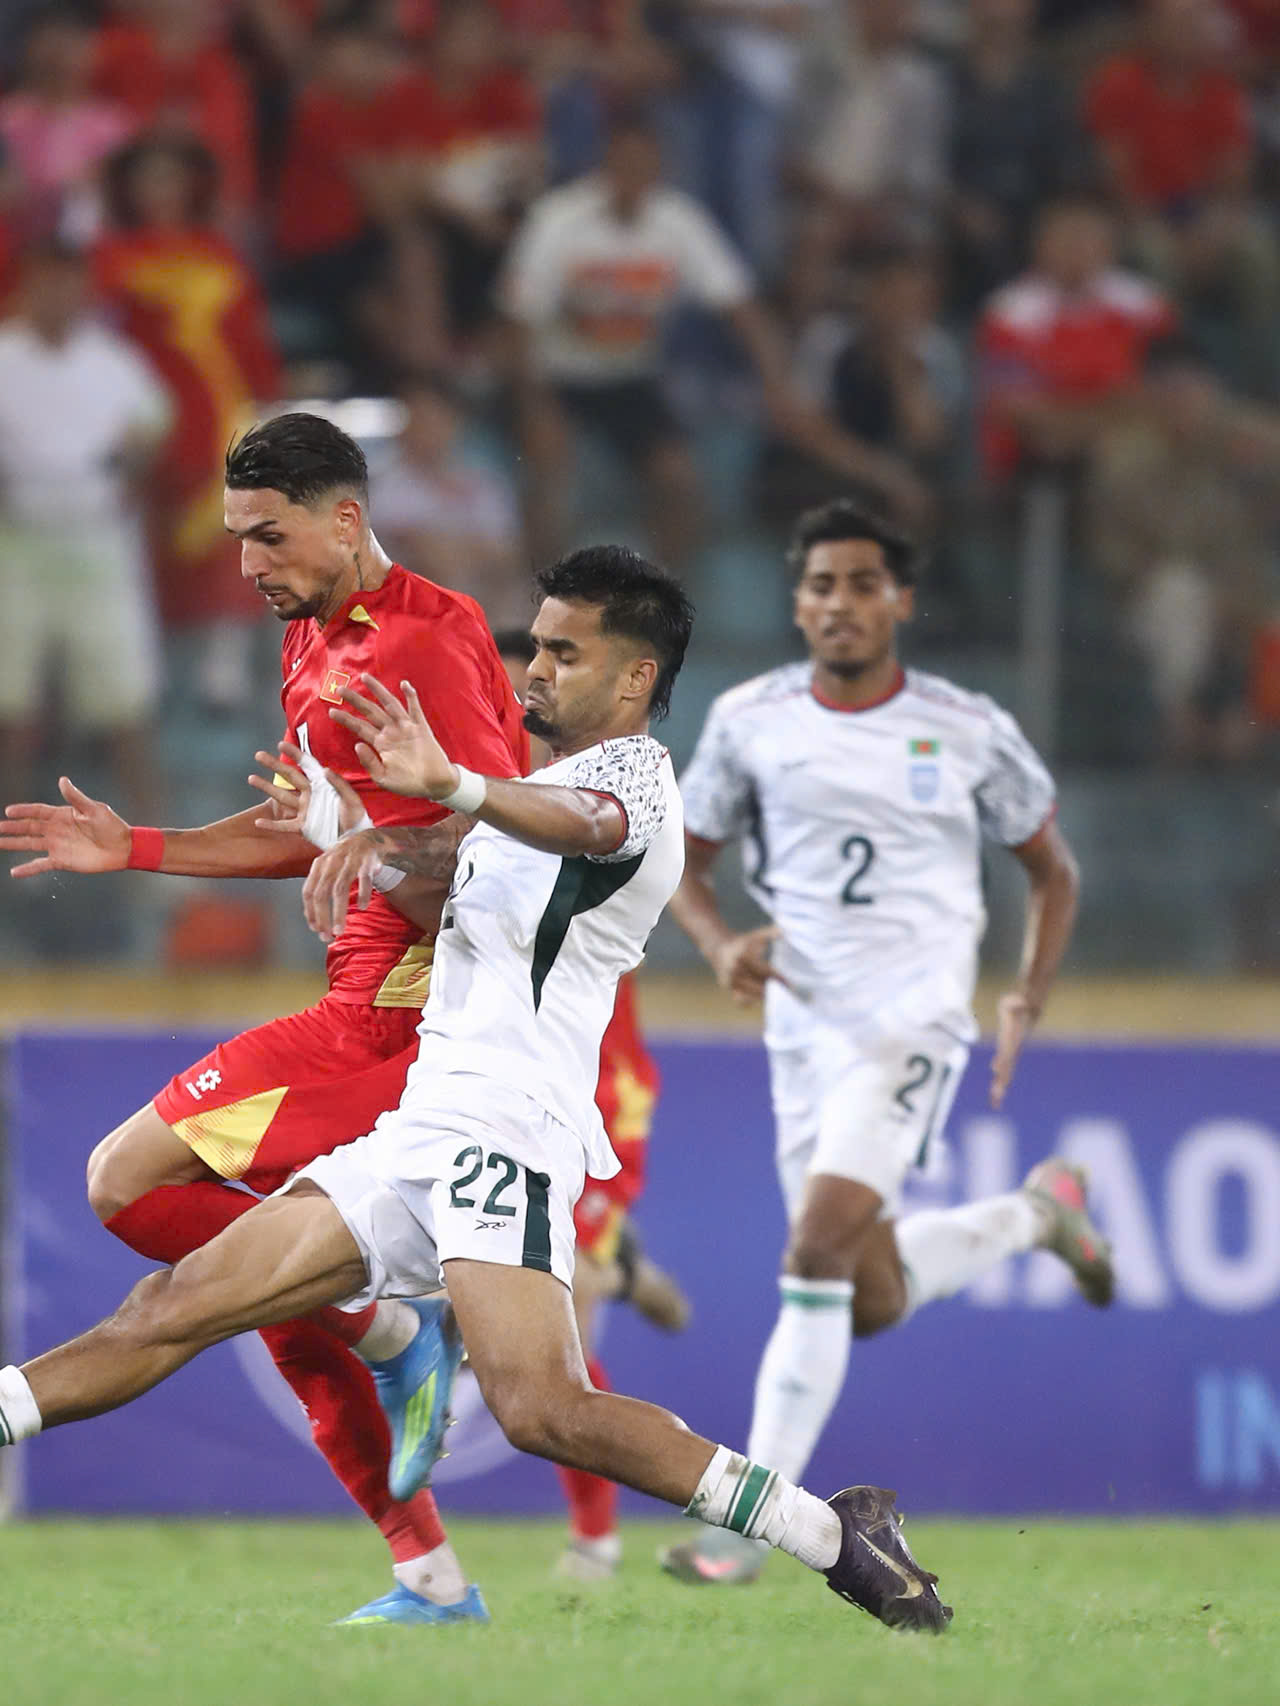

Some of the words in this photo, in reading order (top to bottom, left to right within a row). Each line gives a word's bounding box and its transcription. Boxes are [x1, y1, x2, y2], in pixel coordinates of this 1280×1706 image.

[841, 835, 875, 905] 2
[894, 1053, 932, 1113] 2
[449, 1145, 518, 1217] 22
[901, 1118, 1280, 1311] IAO
